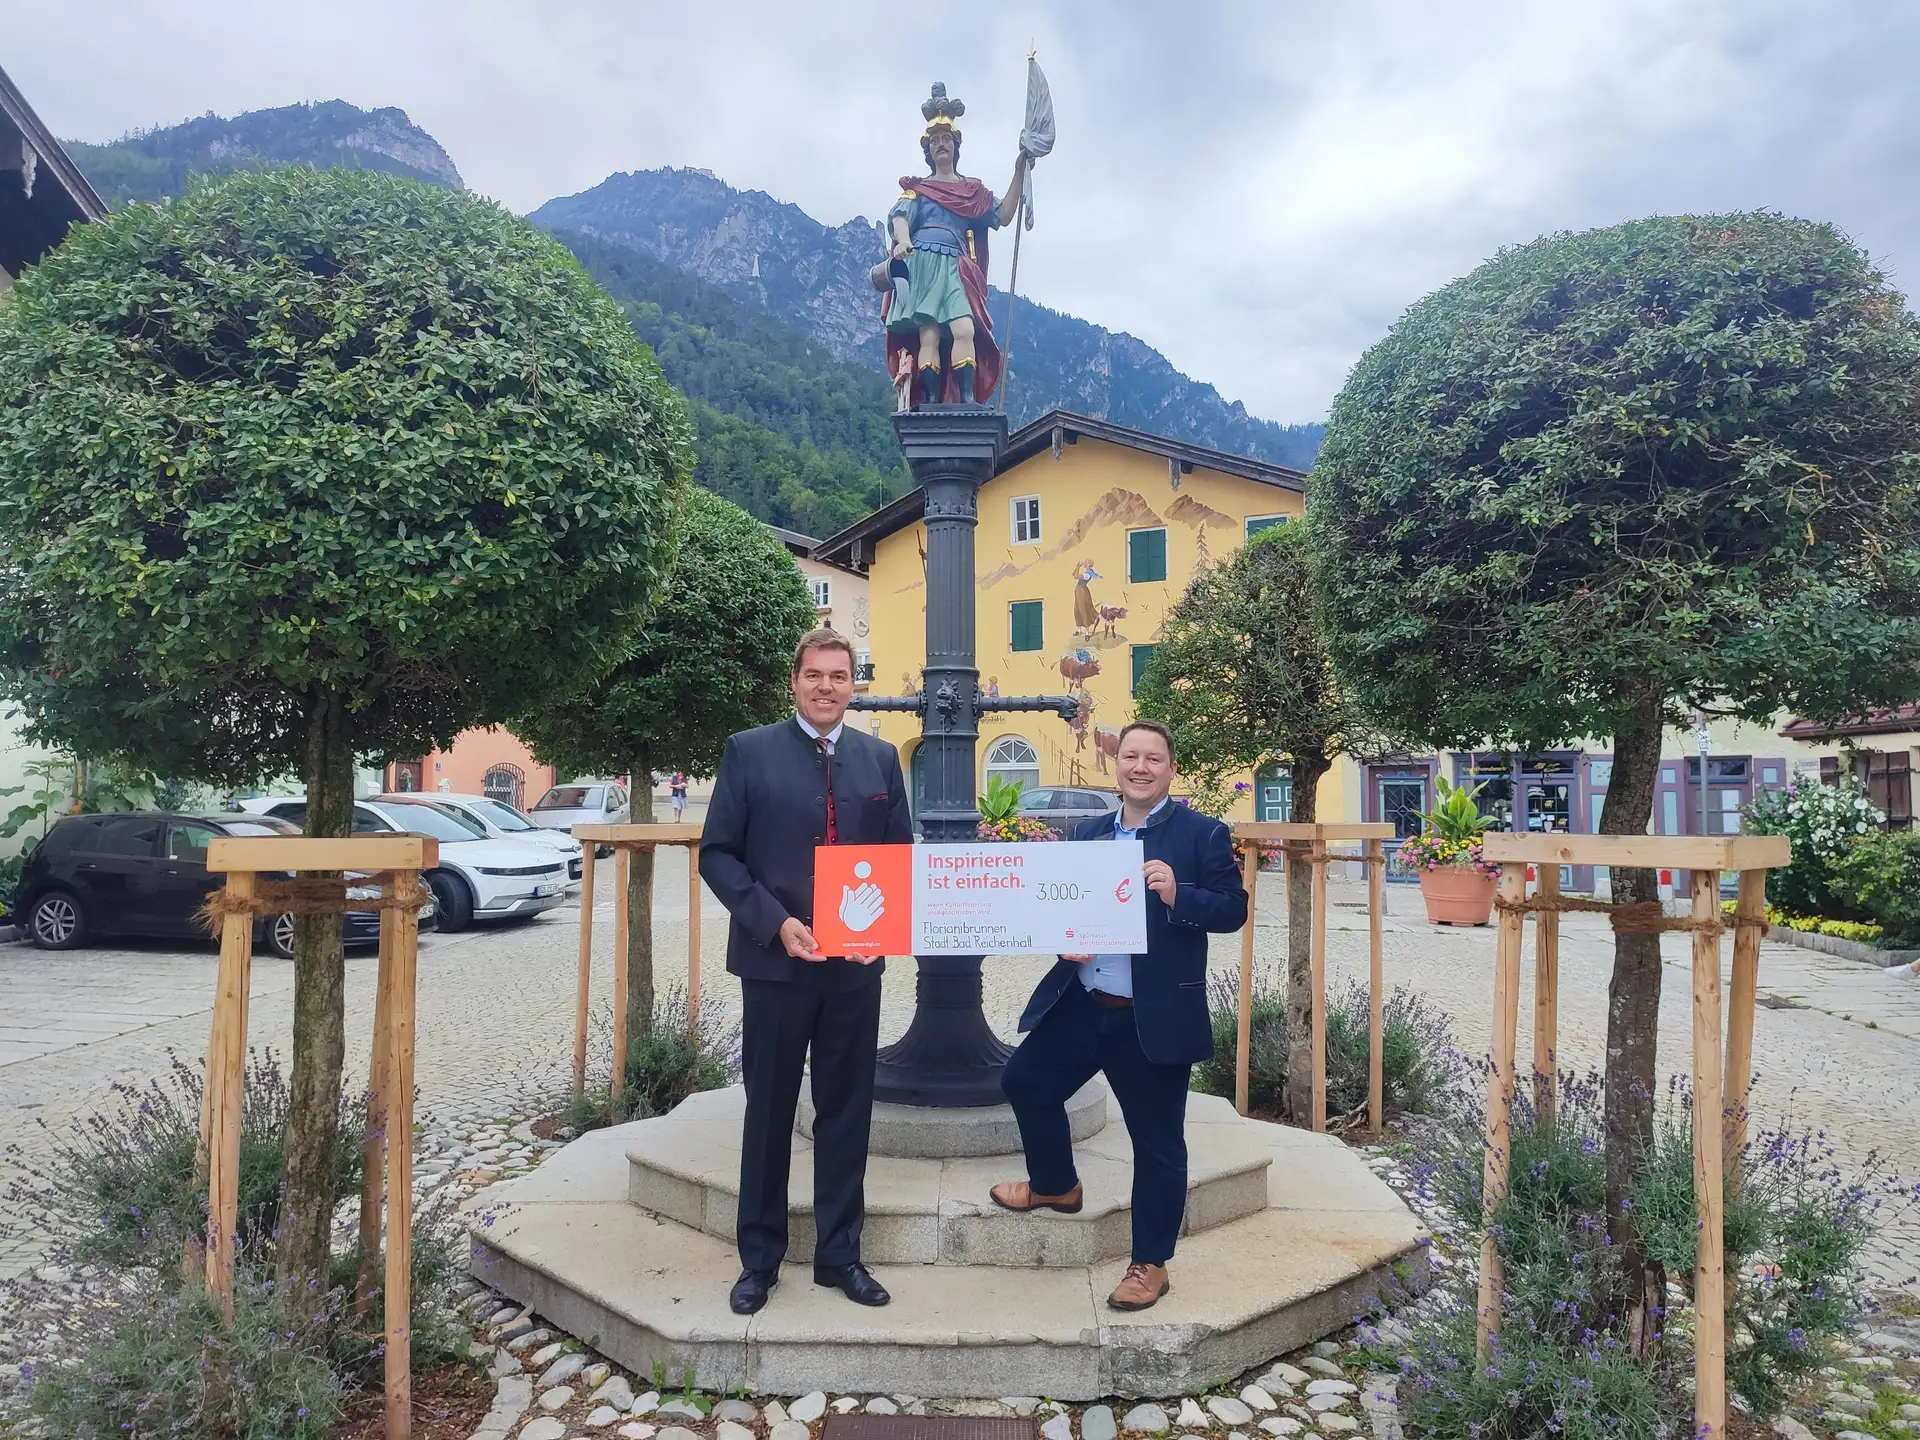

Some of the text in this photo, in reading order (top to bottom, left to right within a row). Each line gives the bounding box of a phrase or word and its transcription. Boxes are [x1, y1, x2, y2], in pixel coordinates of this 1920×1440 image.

[928, 852, 1024, 872] Inspirieren
[928, 872, 1025, 889] ist einfach.
[923, 921, 1007, 934] Florianibrunnen
[923, 935, 1032, 949] Stadt Bad Reichenhall
